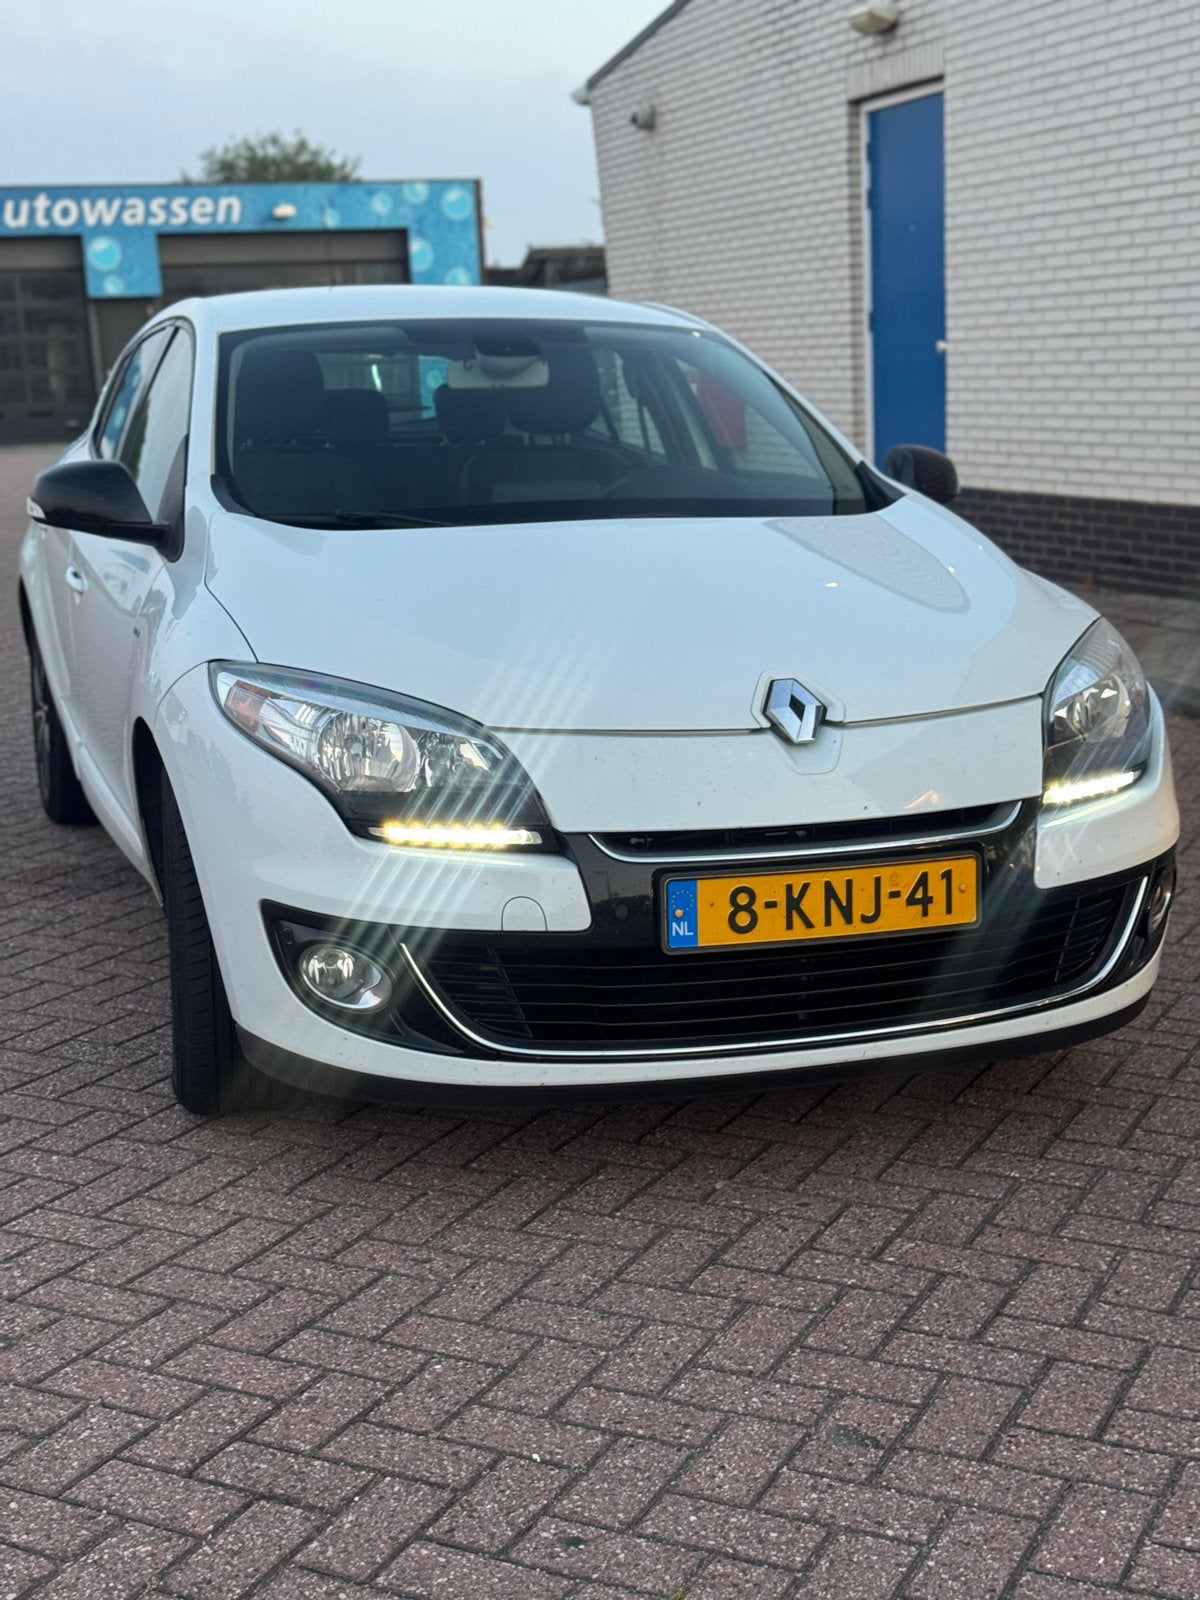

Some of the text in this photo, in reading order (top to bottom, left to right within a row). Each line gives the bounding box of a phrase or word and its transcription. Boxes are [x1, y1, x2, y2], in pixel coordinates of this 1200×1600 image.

[3, 192, 242, 228] utowassen
[727, 868, 953, 934] 8-KNJ-41
[671, 921, 694, 936] NL
